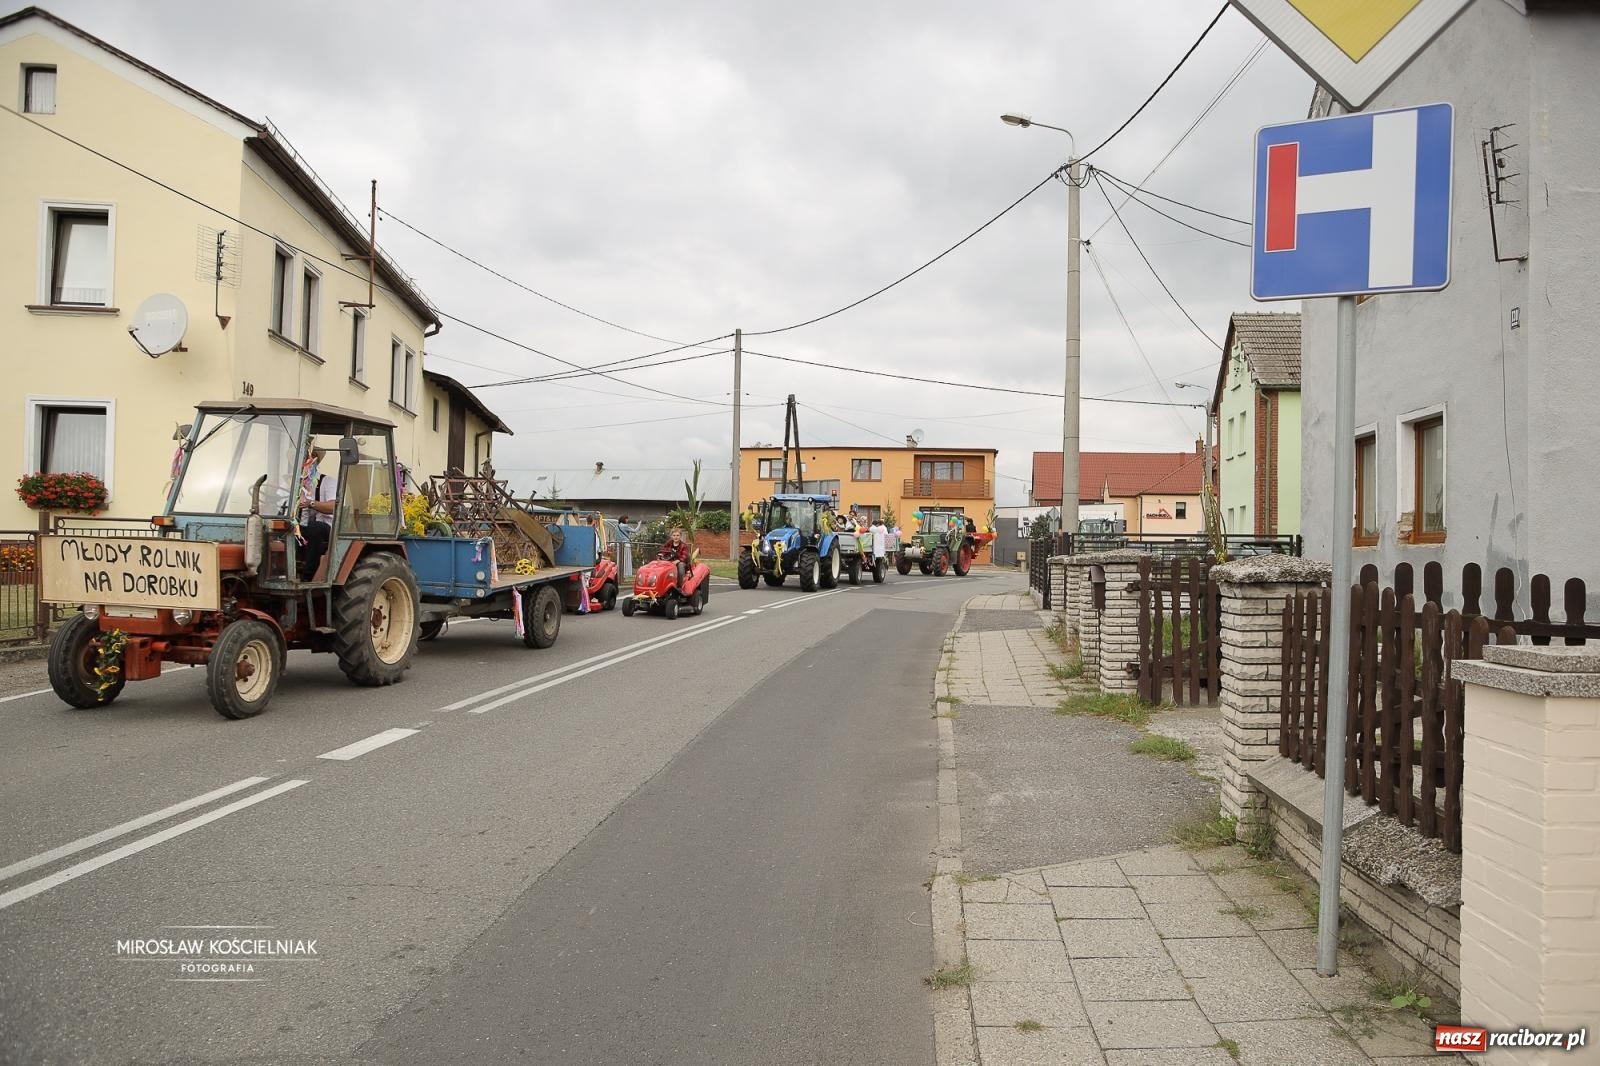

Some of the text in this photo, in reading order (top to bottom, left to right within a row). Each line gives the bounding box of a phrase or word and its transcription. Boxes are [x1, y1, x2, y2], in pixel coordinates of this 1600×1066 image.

[242, 381, 254, 396] 149
[61, 539, 202, 574] MŁODY ROLNIK
[84, 571, 199, 598] NA DOROBKU
